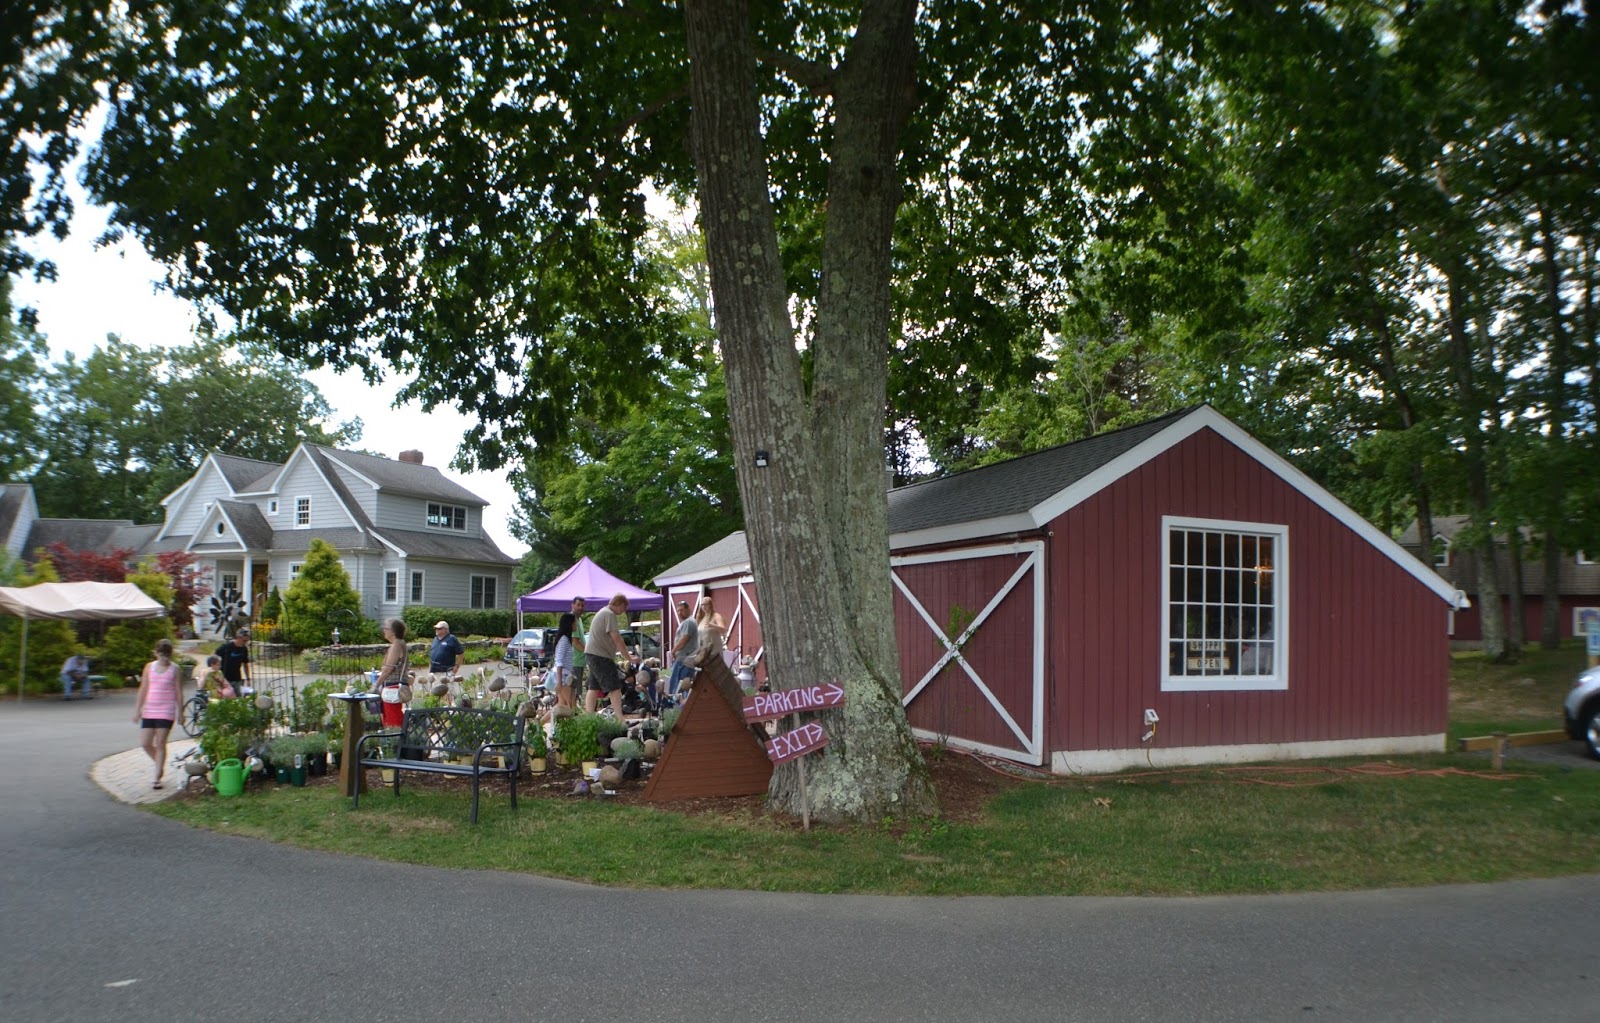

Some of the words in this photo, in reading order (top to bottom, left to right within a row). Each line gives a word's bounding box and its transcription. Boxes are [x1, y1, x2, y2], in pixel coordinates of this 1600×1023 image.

[1192, 641, 1221, 649] SHOPP
[1197, 659, 1220, 668] OPEN
[754, 687, 824, 716] PARKING
[772, 724, 813, 759] EXIT
